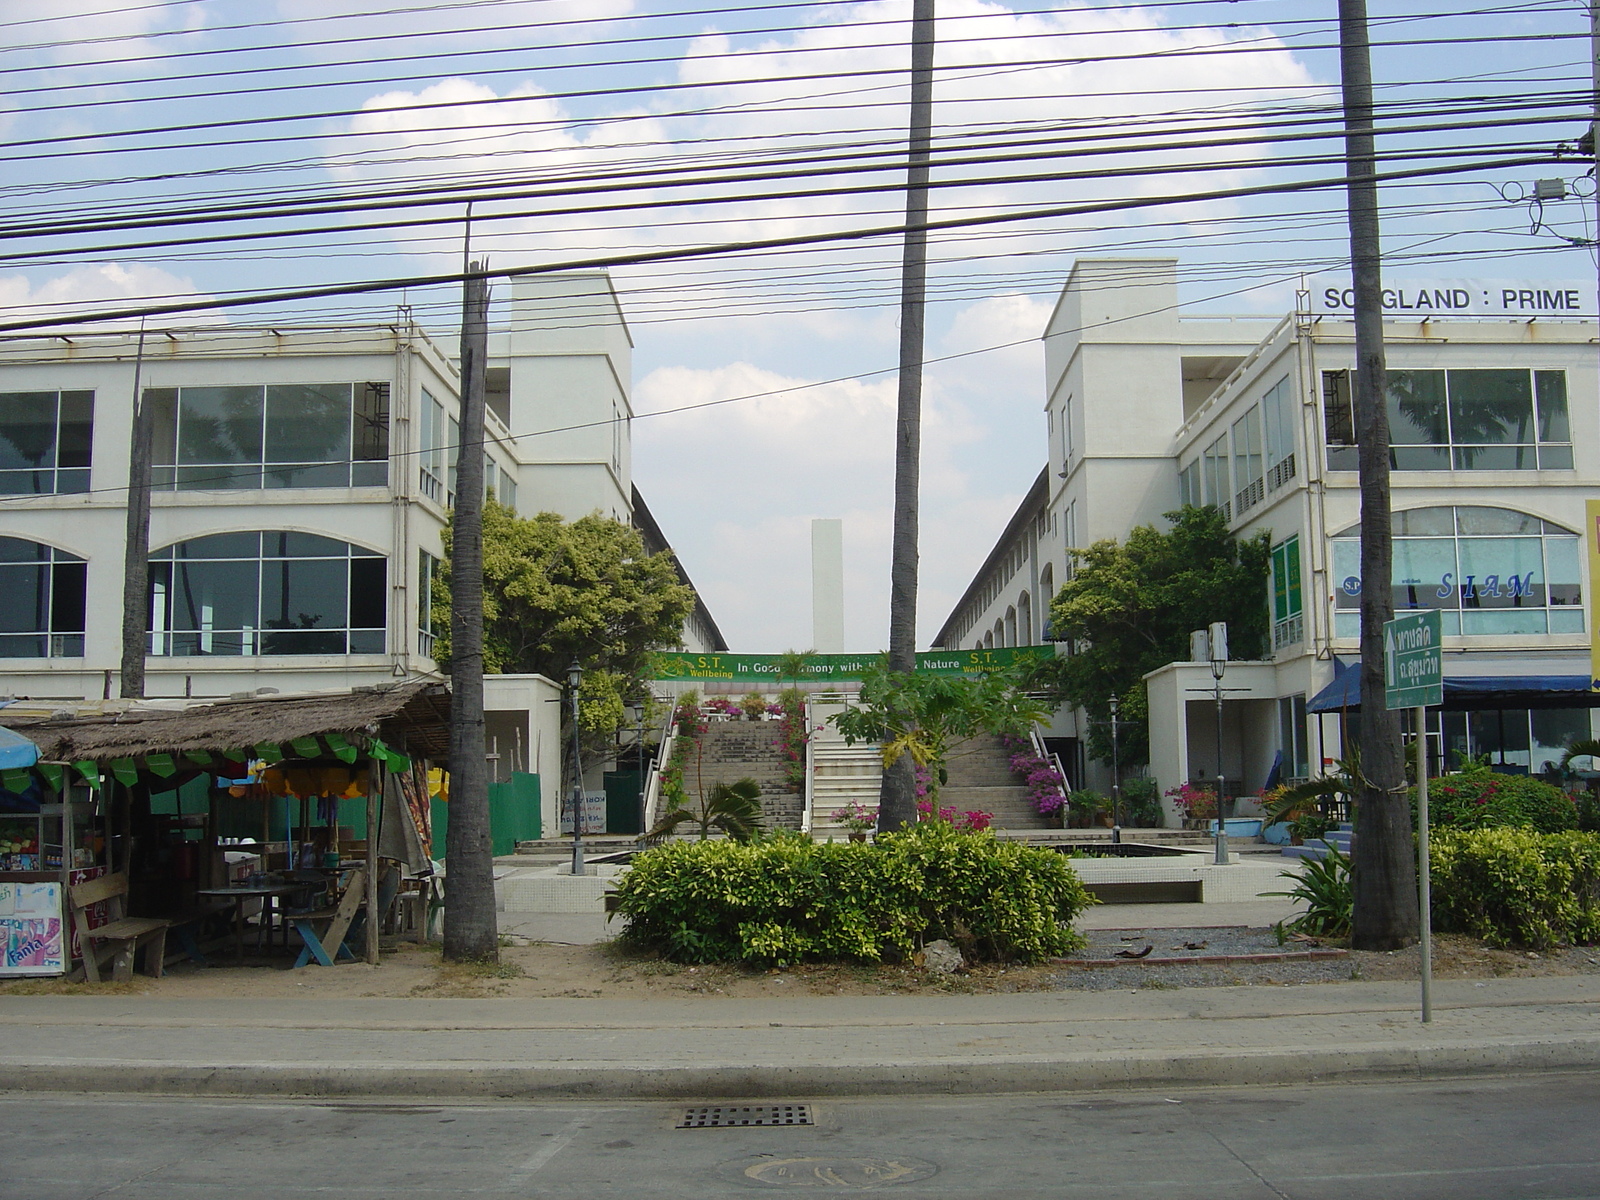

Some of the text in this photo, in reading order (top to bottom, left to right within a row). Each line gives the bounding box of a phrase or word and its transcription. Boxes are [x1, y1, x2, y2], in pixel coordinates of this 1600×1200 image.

[1324, 288, 1470, 309] SOGLAND
[1502, 289, 1580, 310] PRIME
[1436, 571, 1535, 599] SIAM
[1398, 617, 1431, 651] ทางลัด
[698, 657, 725, 669] S.T.
[738, 663, 748, 673] In
[797, 664, 834, 674] mony
[840, 662, 863, 672] with
[923, 660, 959, 669] Nature
[970, 652, 997, 664] S.T.
[1400, 650, 1438, 686] ถ.สุขุมวิท
[690, 670, 733, 679] Wellbeing
[9, 939, 43, 963] Fanta
